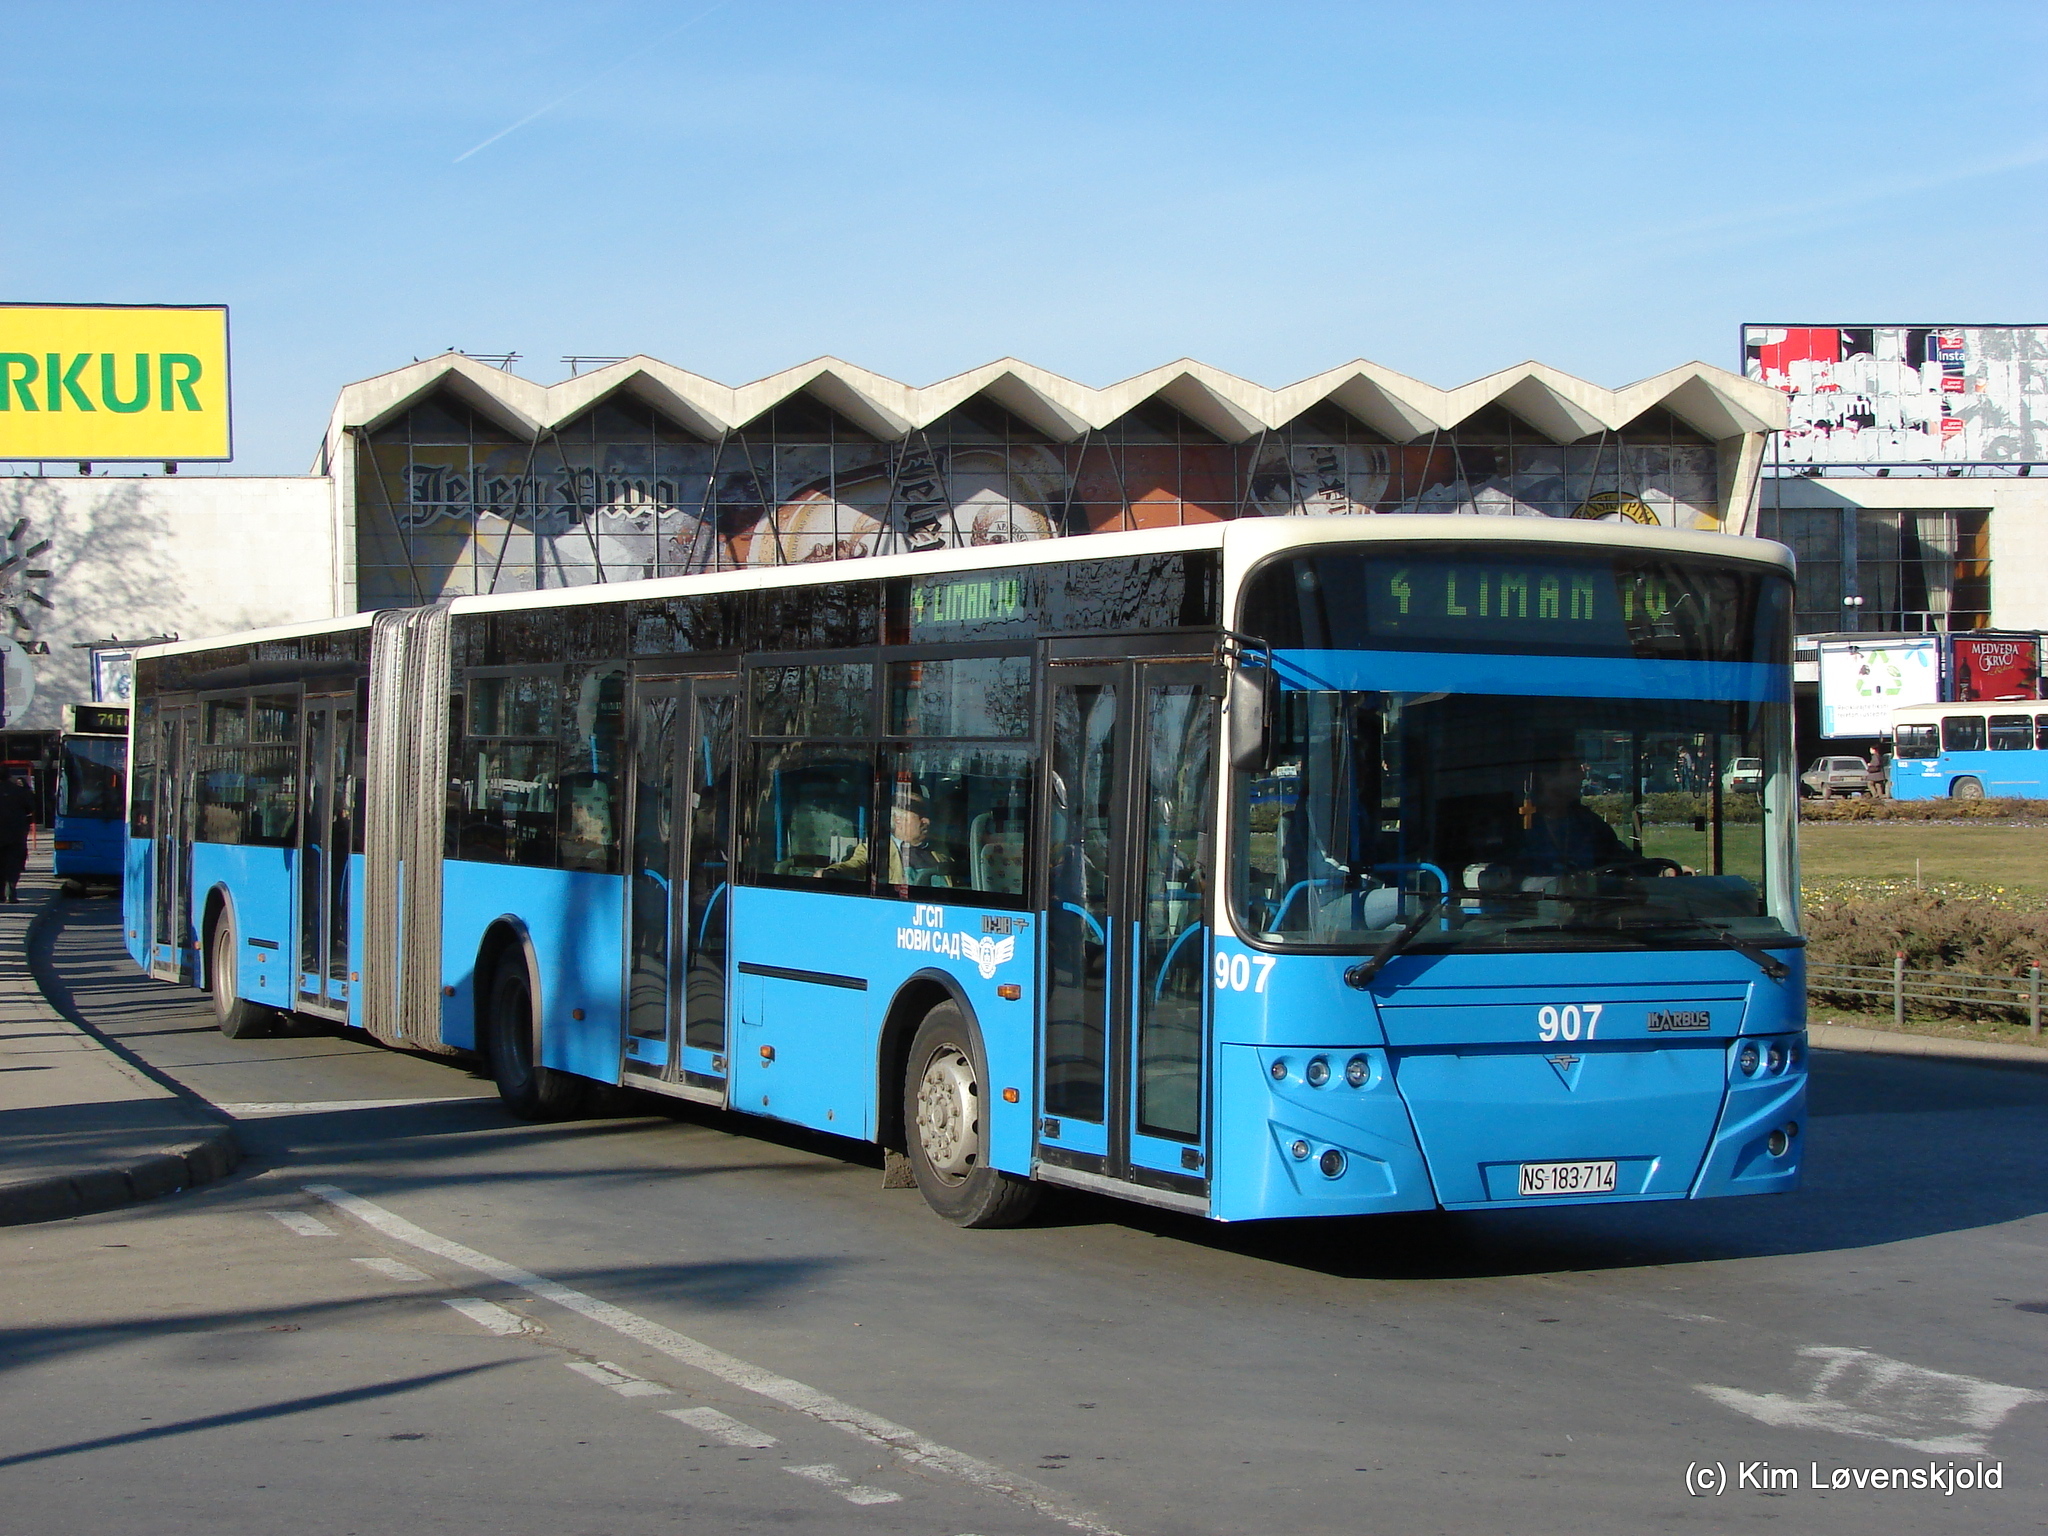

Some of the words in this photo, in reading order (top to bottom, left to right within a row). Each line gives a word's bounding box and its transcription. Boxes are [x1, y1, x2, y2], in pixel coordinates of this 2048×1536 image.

[0, 352, 204, 413] RKUR
[401, 463, 550, 528] Jelen
[556, 464, 680, 525] Pivo
[913, 587, 925, 623] 4
[933, 582, 992, 622] LIMAN
[996, 579, 1018, 617] IV
[1390, 568, 1412, 615] 4
[1446, 569, 1594, 620] LIMAN
[97, 713, 114, 726] 71
[897, 927, 931, 952] НОВИ
[932, 932, 961, 960] САД
[1214, 951, 1277, 994] 907
[1538, 1004, 1604, 1042] 907
[1647, 1009, 1711, 1031] IKARBUS
